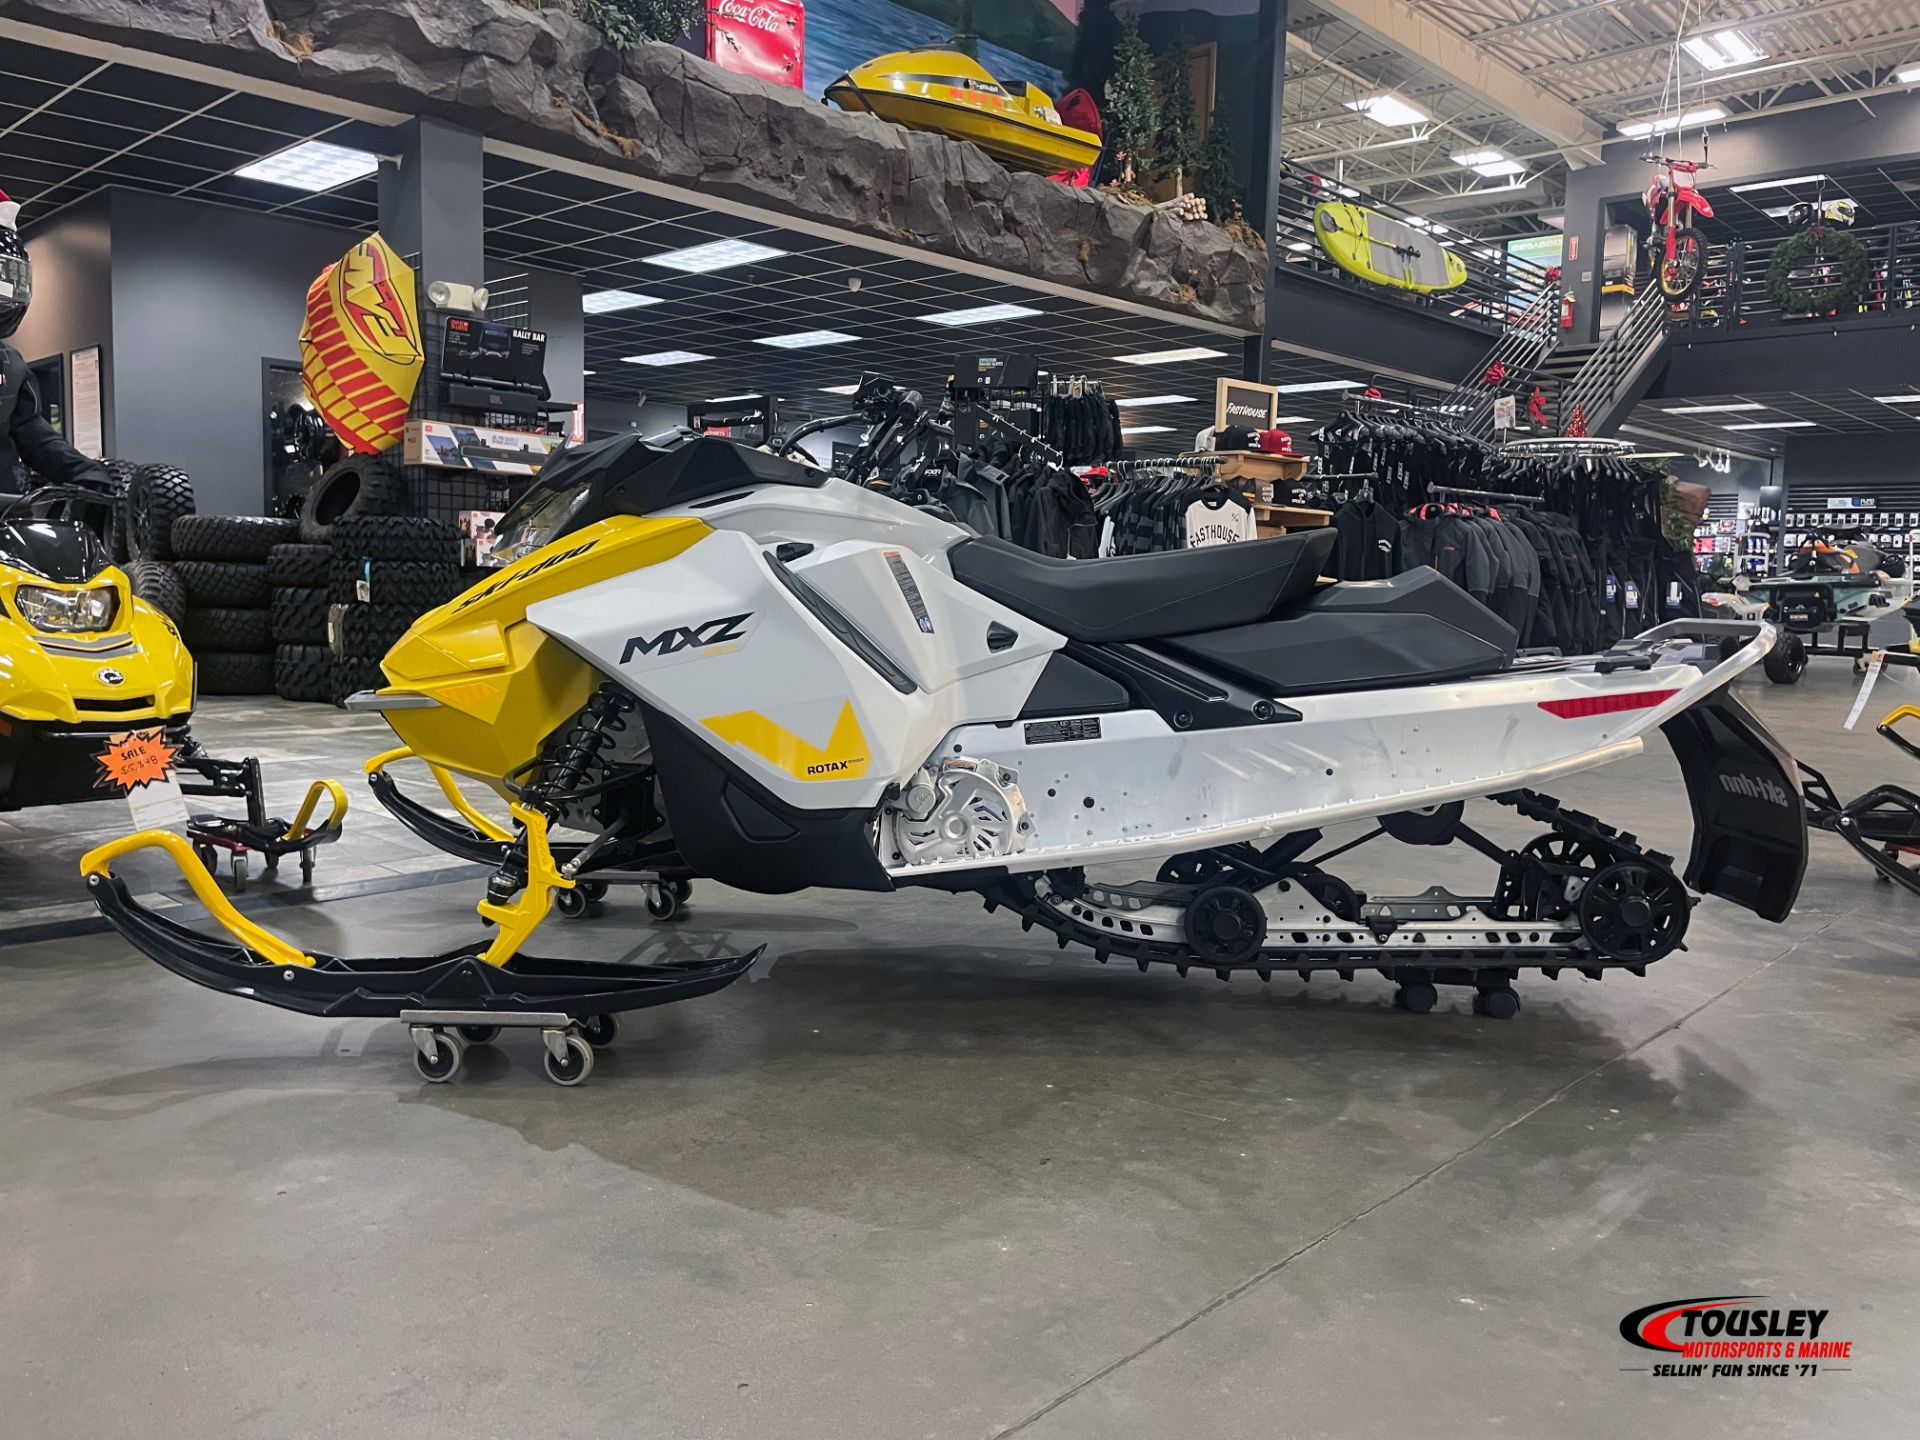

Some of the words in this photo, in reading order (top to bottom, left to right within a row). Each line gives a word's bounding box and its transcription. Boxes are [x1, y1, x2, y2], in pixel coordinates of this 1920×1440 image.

[512, 329, 532, 340] RALLY
[532, 333, 546, 343] BAR
[1226, 402, 1268, 418] FASTHOUSE
[619, 611, 755, 665] MXZ
[121, 746, 146, 761] SALE
[807, 761, 848, 775] ROTAX
